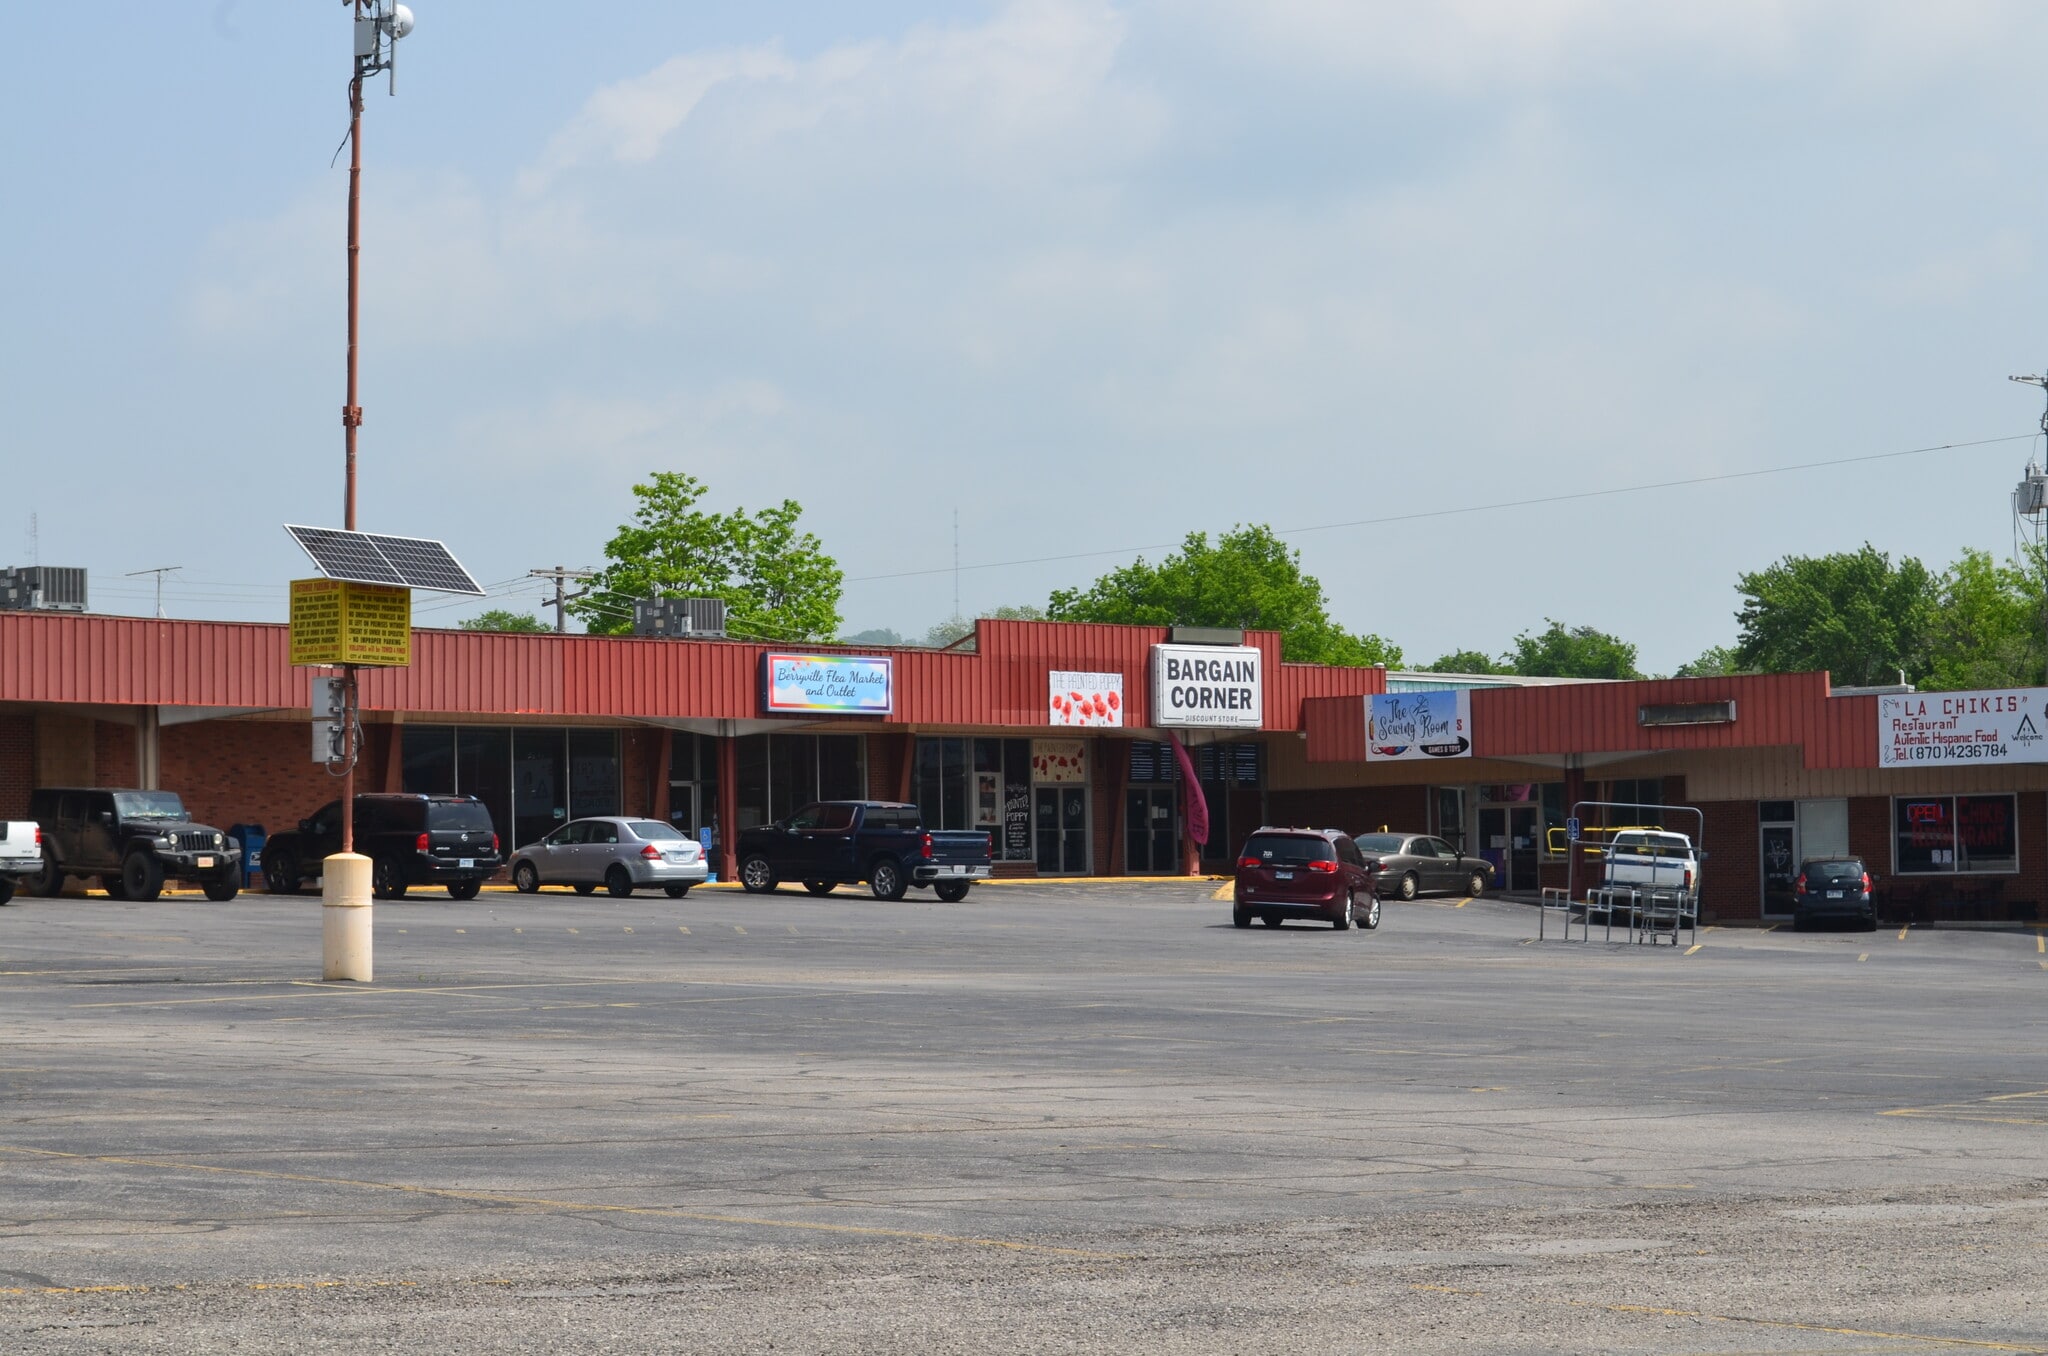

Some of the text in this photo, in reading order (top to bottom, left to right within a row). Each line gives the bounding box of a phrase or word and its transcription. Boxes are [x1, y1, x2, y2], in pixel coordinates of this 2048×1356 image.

[778, 667, 884, 684] Berryville Flea Market
[1167, 658, 1255, 682] BARGAIN
[805, 684, 856, 697] and Outlet
[1171, 686, 1252, 710] CORNER
[1218, 715, 1238, 723] STORE
[1385, 699, 1407, 723] The
[1378, 714, 1449, 742] Sewing Room
[1932, 731, 1973, 748] Hispanic
[1975, 729, 1998, 743] Food
[2011, 732, 2043, 742] Welcome
[1006, 811, 1029, 822] POPPY
[1909, 805, 1941, 820] OPEN
